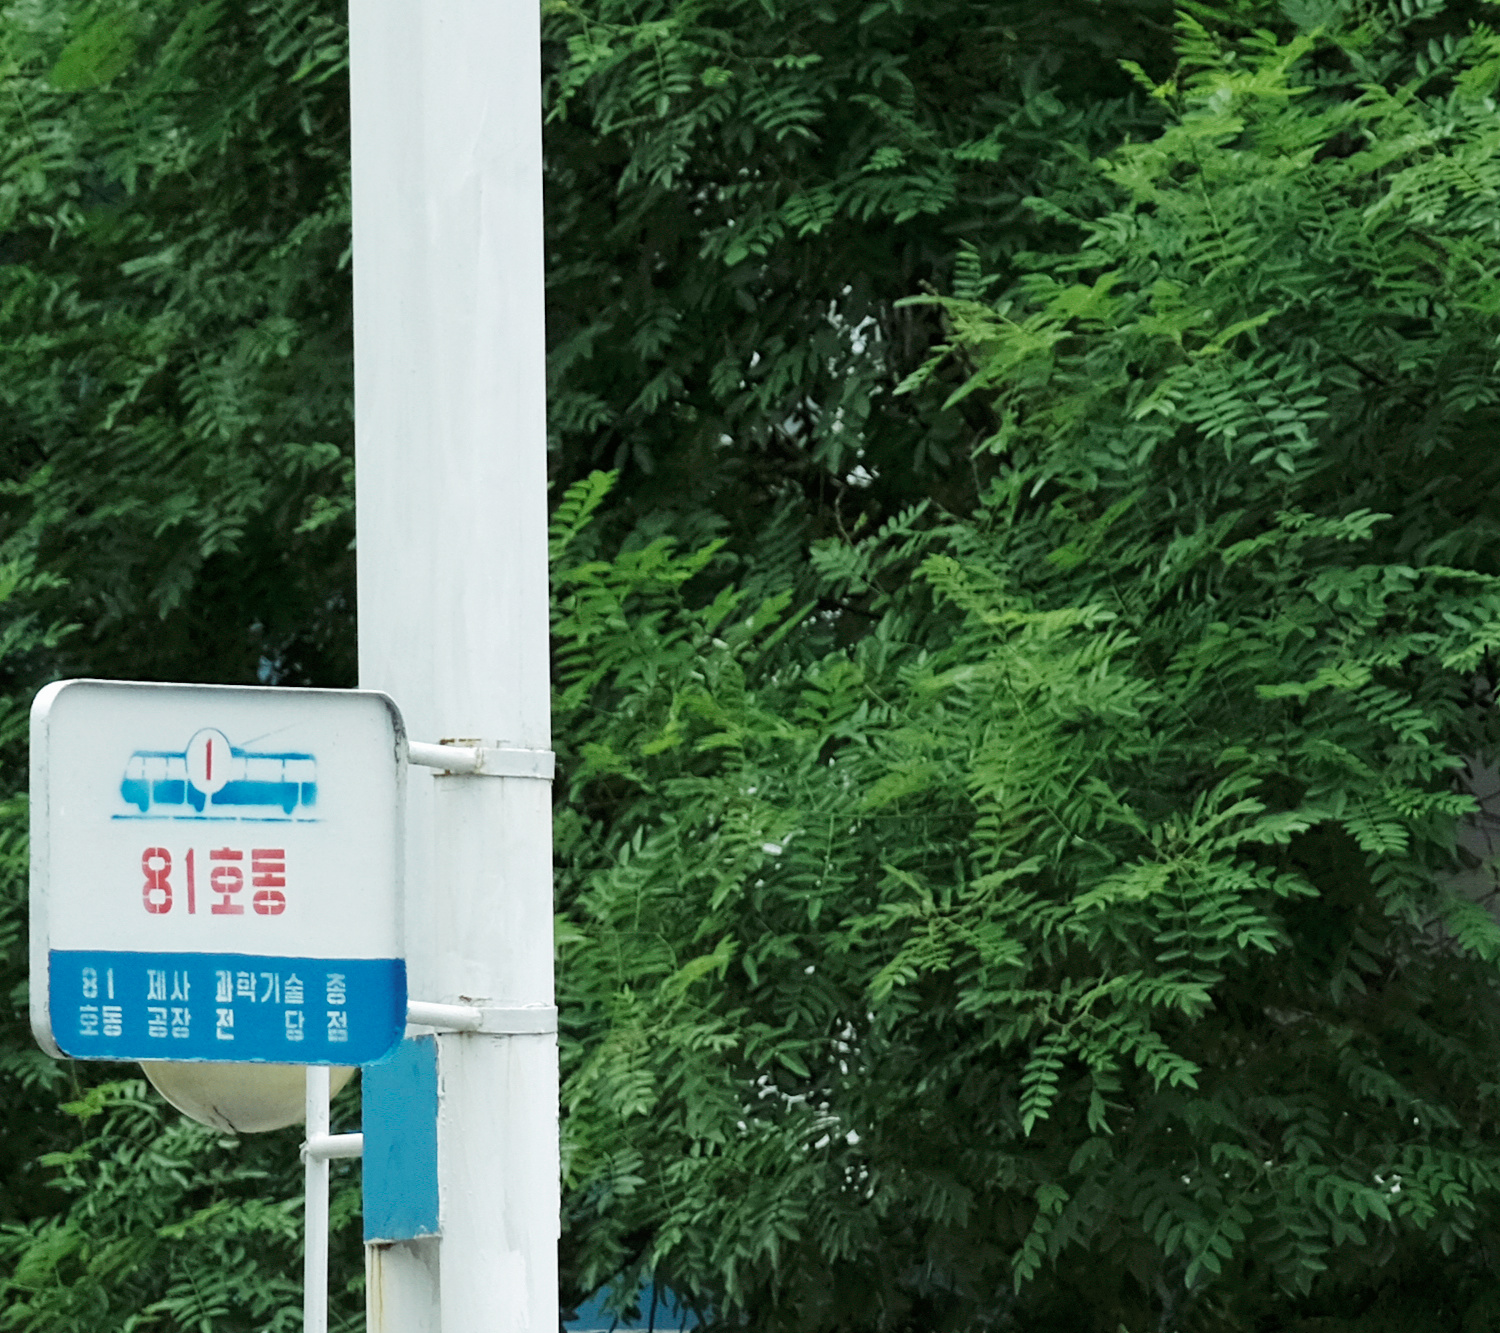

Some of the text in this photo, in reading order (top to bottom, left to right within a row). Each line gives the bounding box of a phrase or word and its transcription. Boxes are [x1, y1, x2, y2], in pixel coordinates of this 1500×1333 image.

[205, 738, 212, 781] 1
[141, 846, 286, 915] 81호동
[81, 966, 347, 1006] 81 제사 과학기술 종
[79, 1004, 123, 1037] 호동
[147, 1006, 191, 1039] 공장
[326, 1010, 348, 1043] 점
